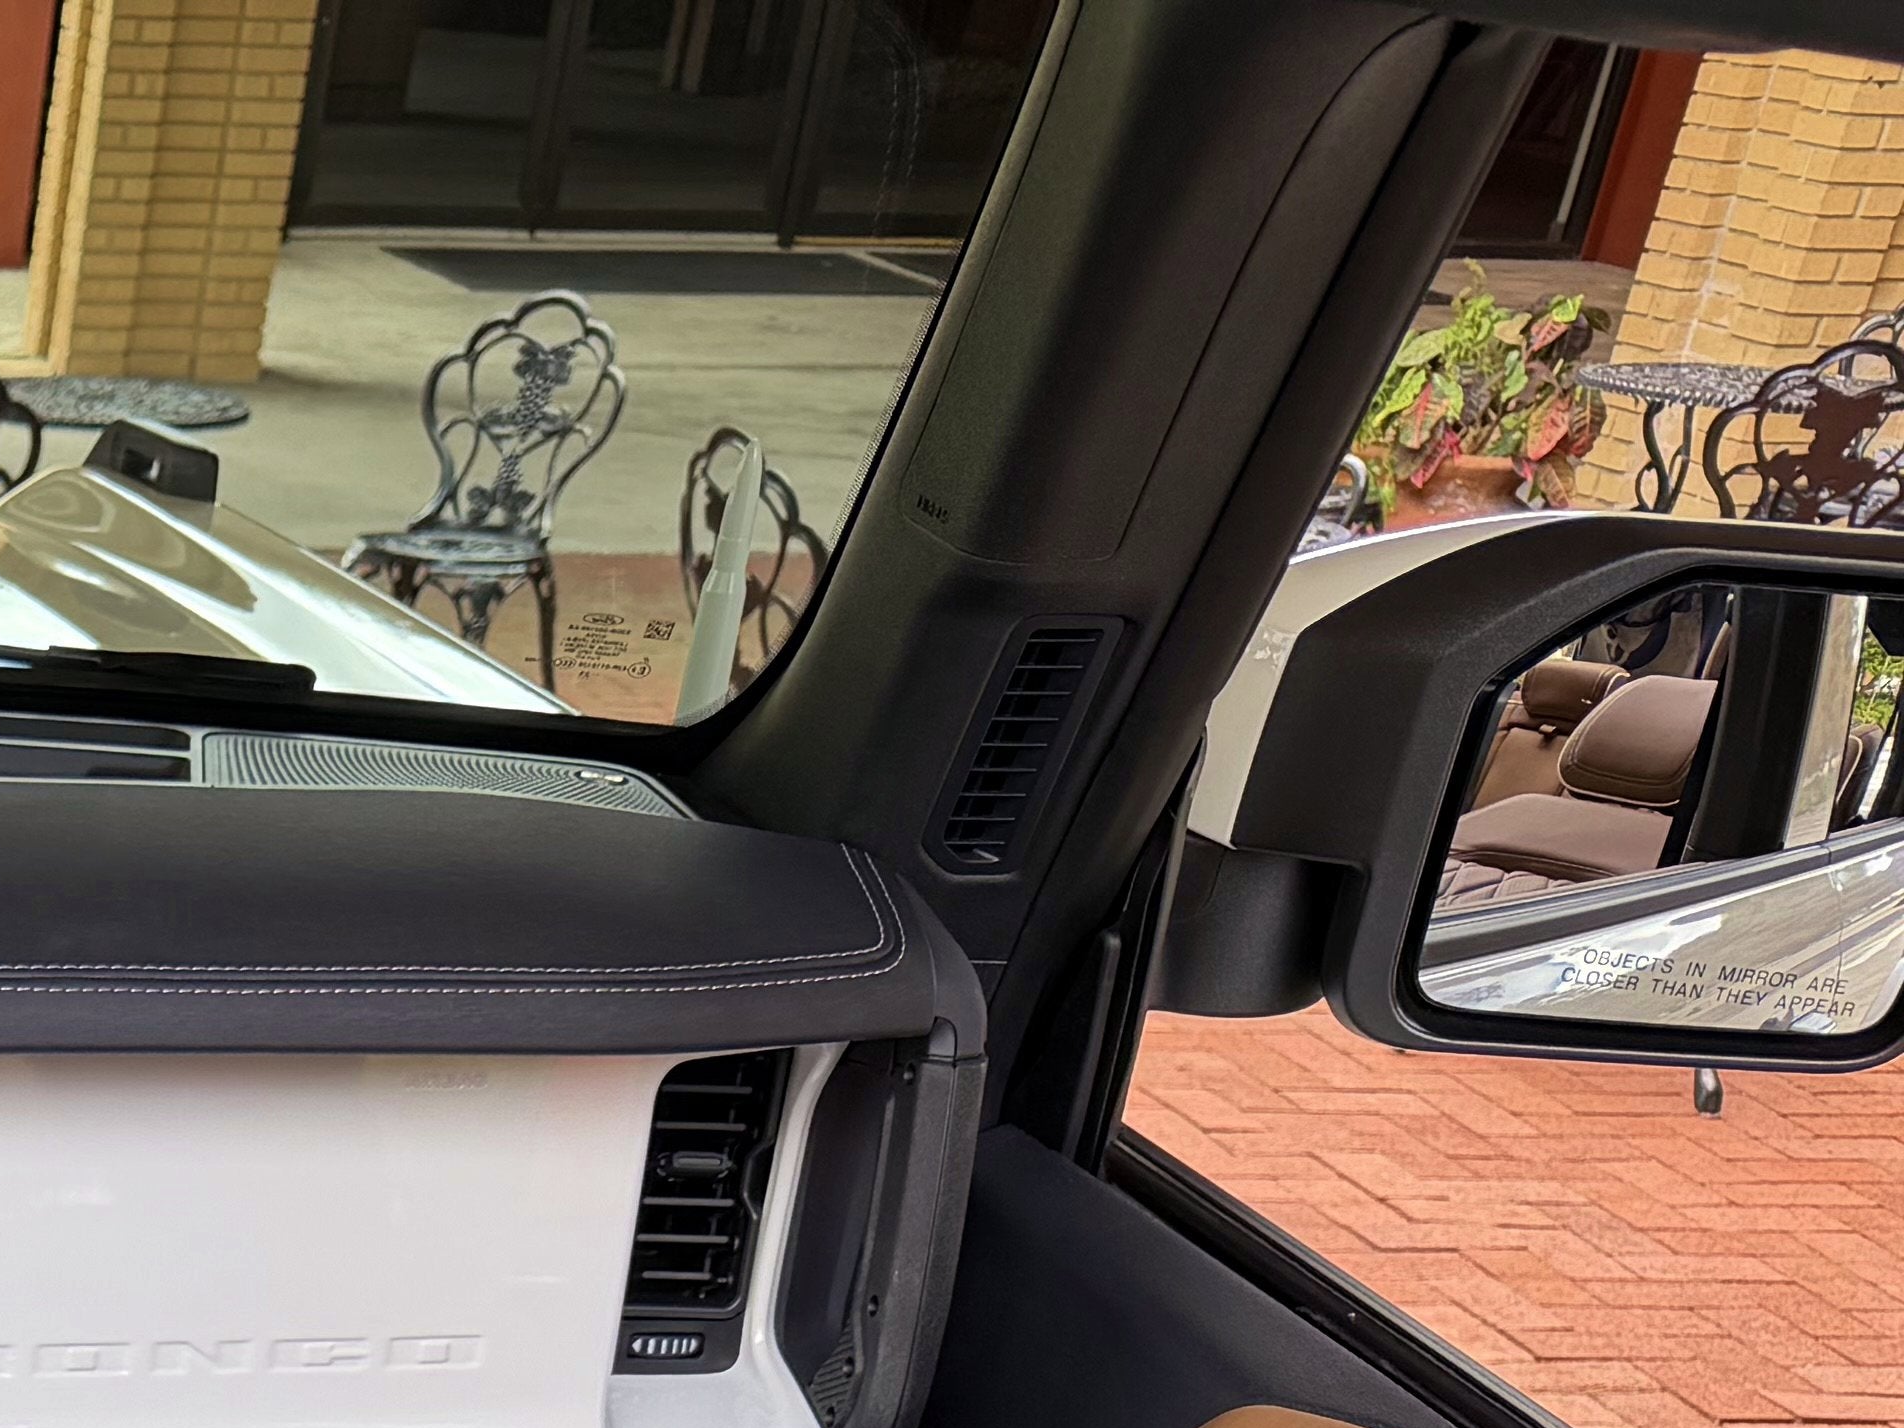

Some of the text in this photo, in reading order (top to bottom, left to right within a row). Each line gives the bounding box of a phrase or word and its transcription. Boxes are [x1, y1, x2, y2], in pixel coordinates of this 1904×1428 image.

[1561, 967, 1855, 1018] CLOSER THAN THEY APPEAR
[1584, 949, 1849, 995] OBJECTS IN MIRROR ARE
